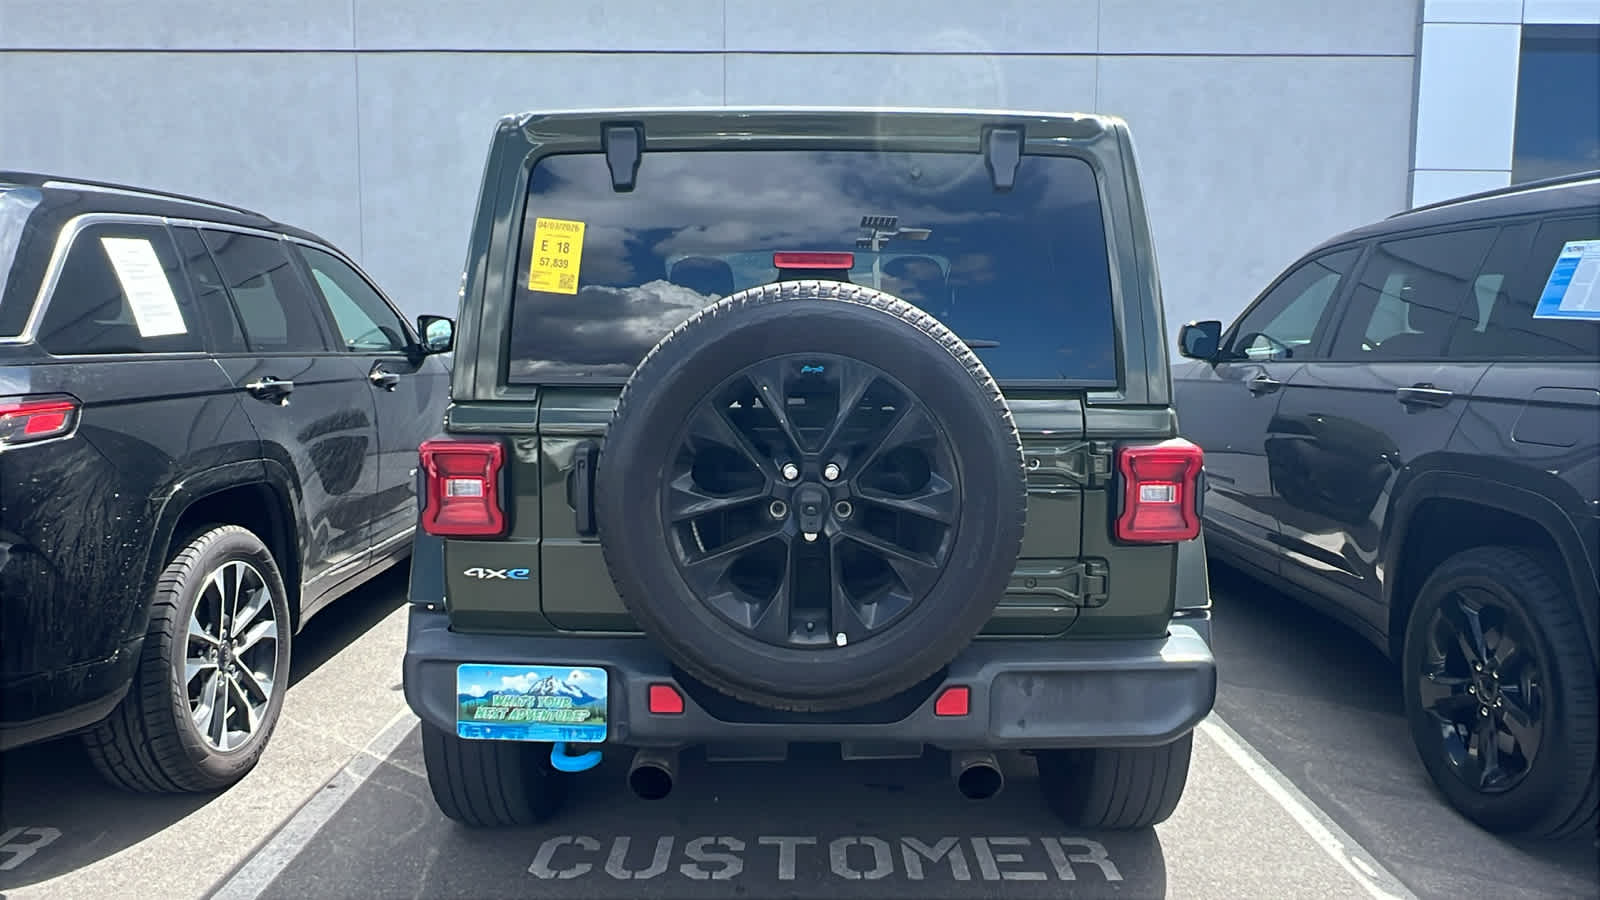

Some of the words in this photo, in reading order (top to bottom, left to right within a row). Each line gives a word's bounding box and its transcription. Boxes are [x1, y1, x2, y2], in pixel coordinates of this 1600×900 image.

[541, 240, 548, 252] E
[557, 242, 570, 254] 18
[537, 695, 572, 708] YOUR
[474, 706, 509, 720] NEXT
[508, 708, 590, 722] ADVENTURE?
[527, 835, 1124, 881] CUSTOMER
